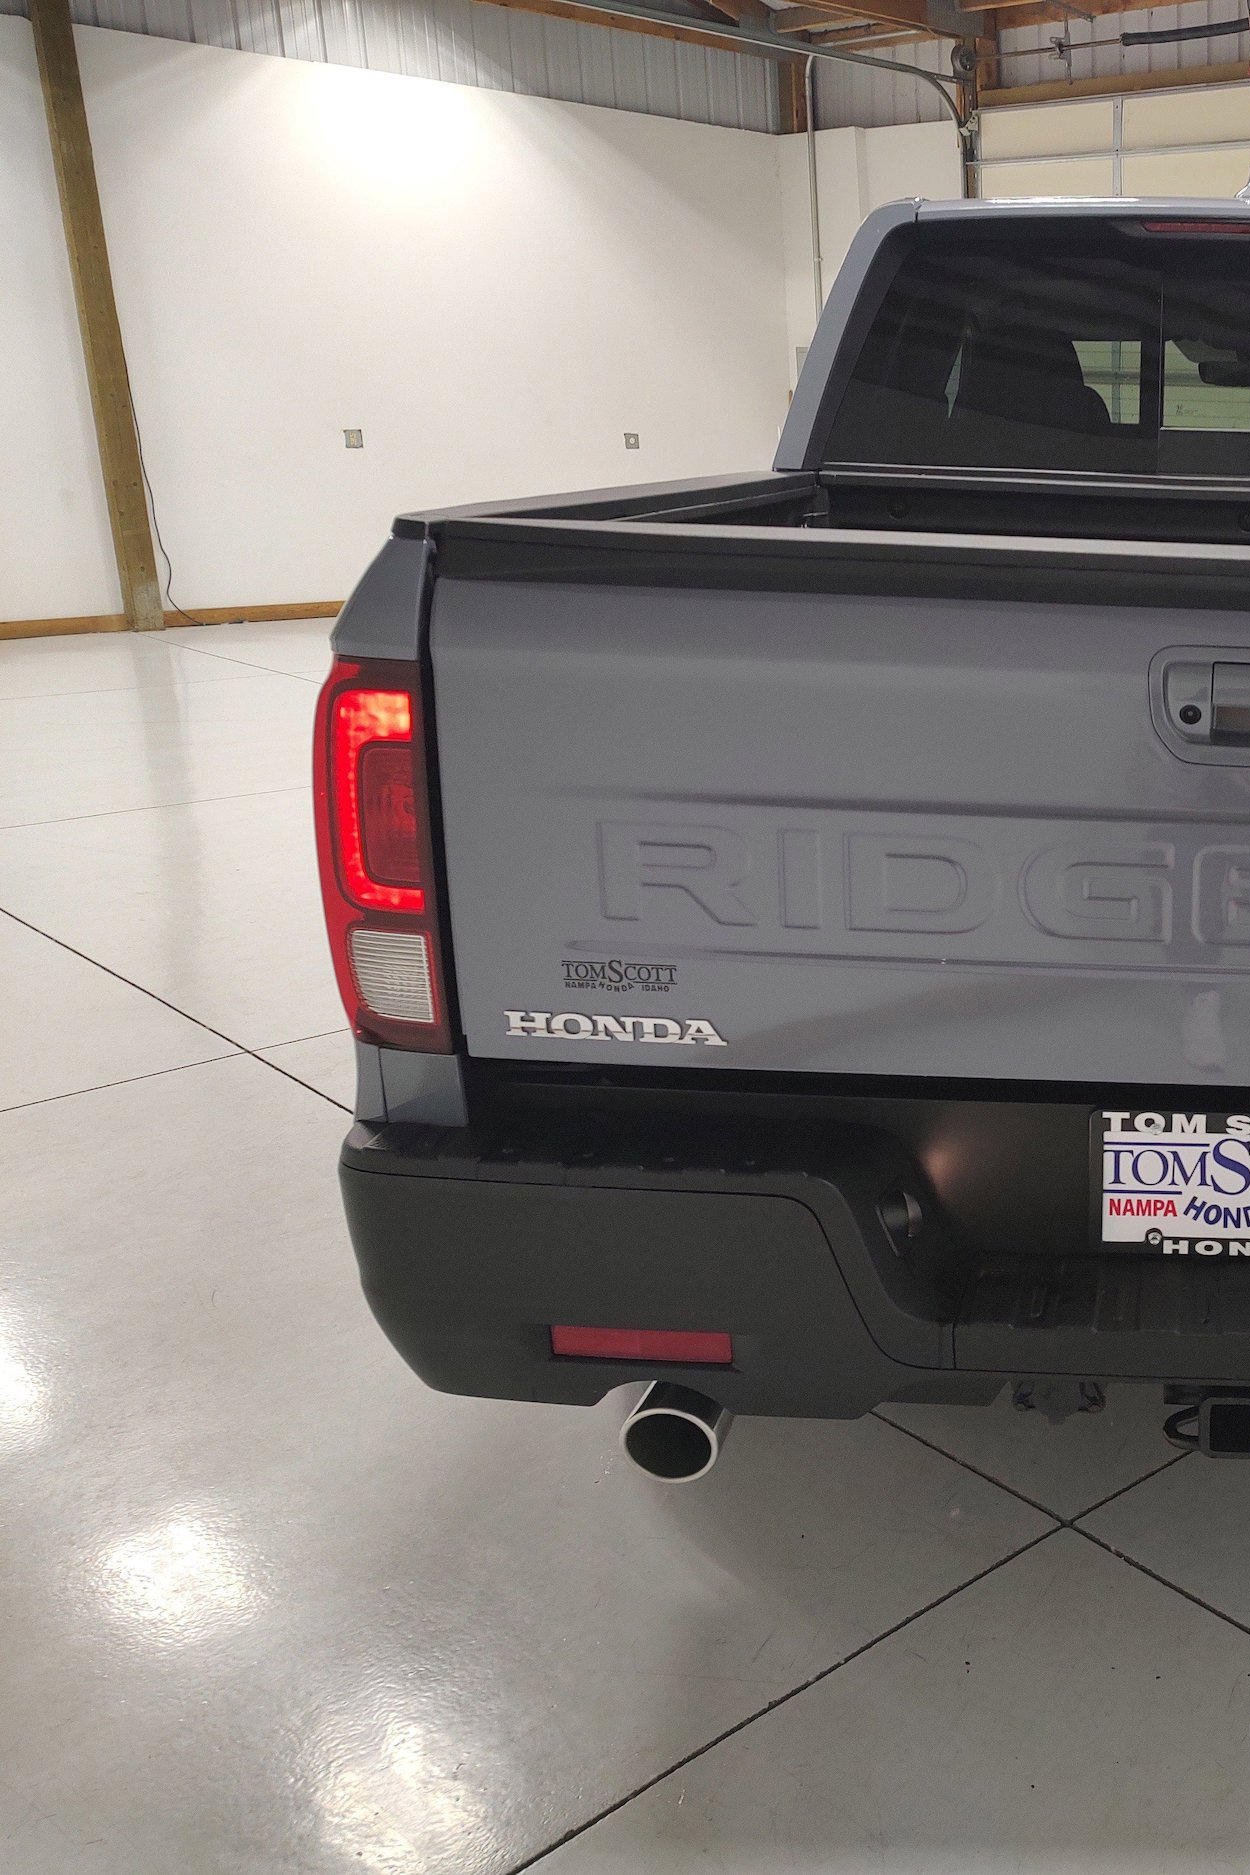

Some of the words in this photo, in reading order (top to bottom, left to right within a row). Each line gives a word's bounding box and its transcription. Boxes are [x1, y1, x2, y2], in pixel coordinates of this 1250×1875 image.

[565, 982, 596, 990] NAMPA
[598, 982, 635, 992] HONDA
[641, 985, 670, 993] IDAHO
[503, 1010, 728, 1046] HONDA
[1102, 1112, 1207, 1134] TOM
[1108, 1198, 1178, 1217] NAMPA
